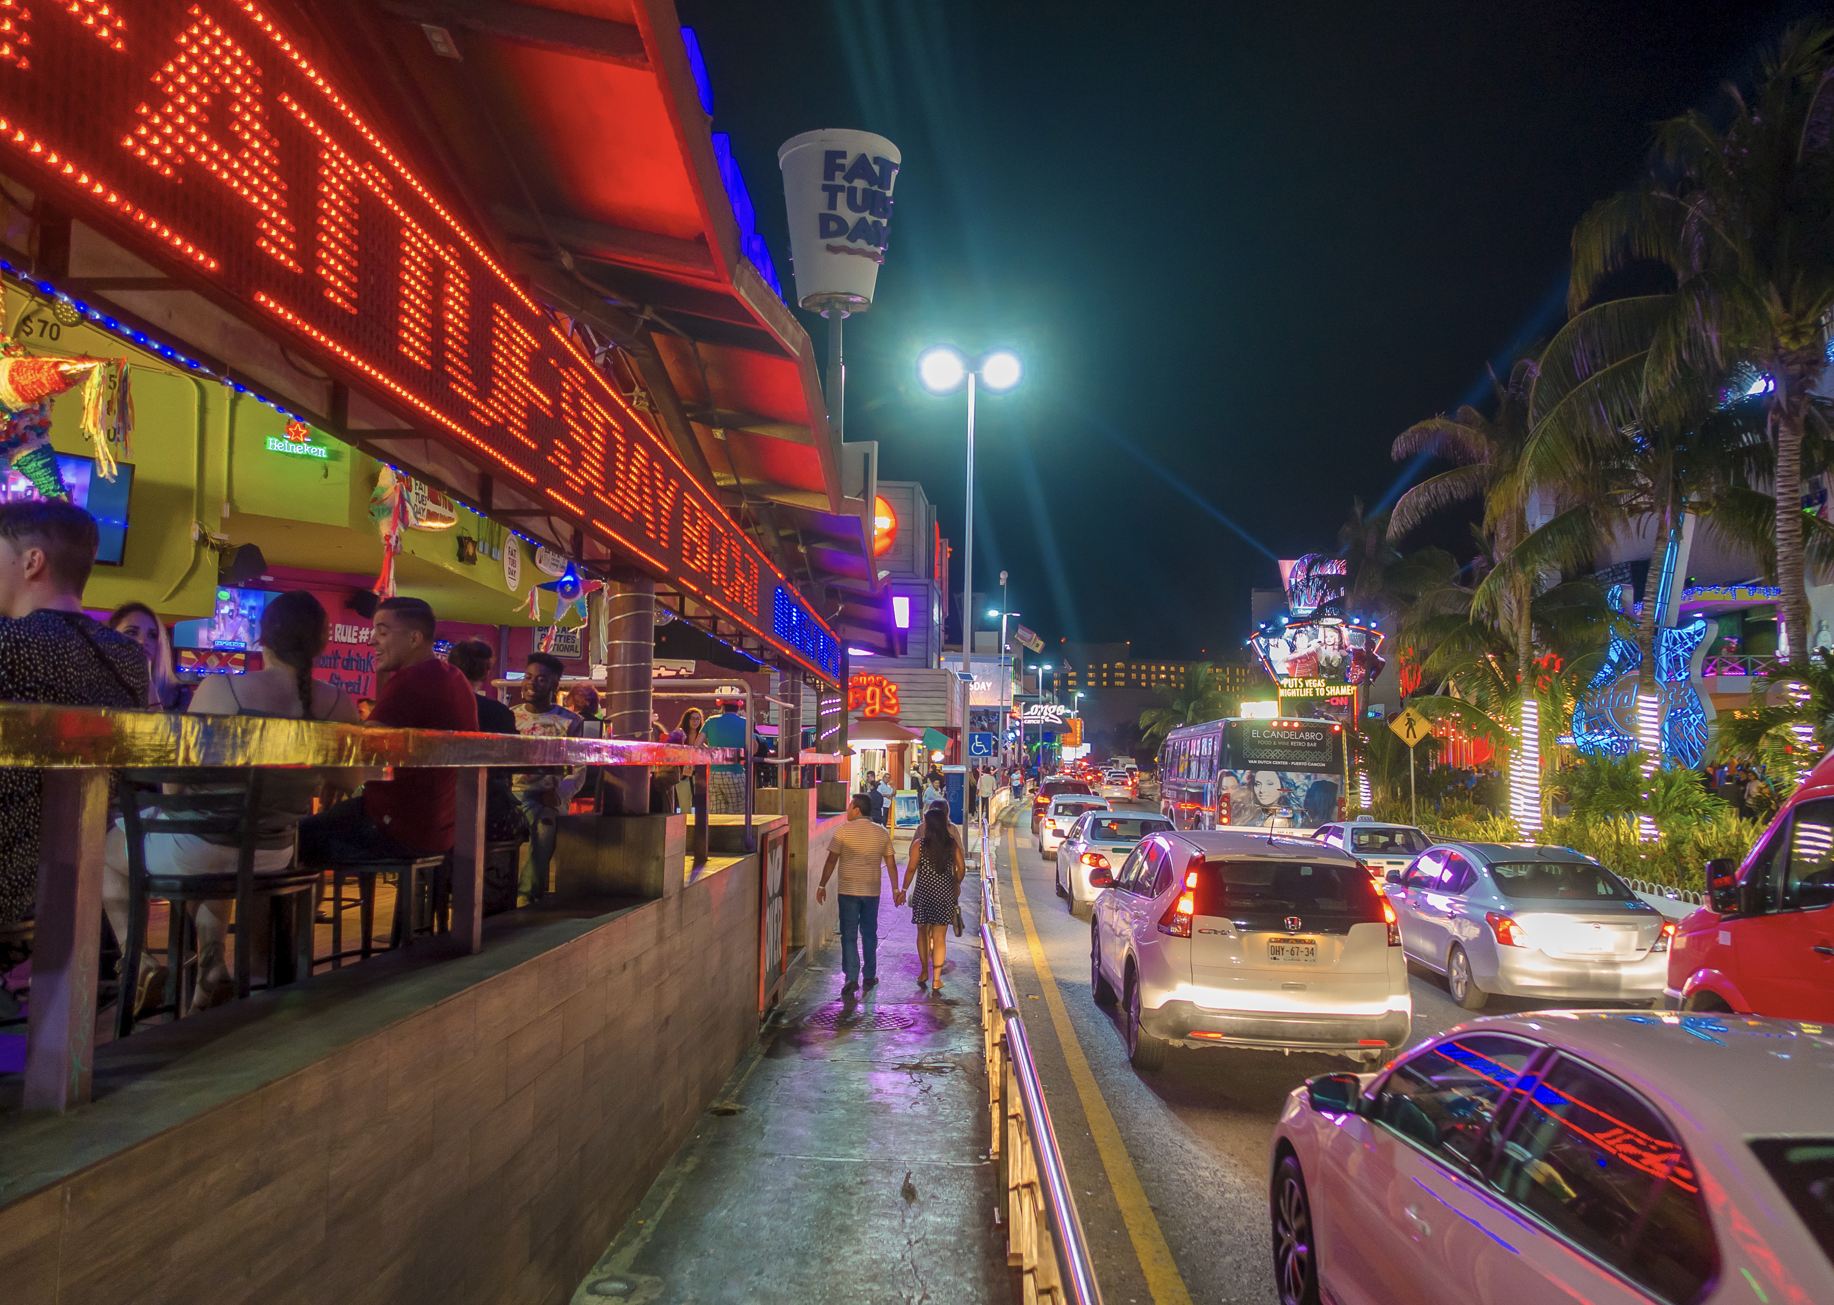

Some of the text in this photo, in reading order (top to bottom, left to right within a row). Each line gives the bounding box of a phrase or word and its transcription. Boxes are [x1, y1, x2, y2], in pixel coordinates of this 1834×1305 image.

[823, 150, 900, 190] FAT
[819, 212, 890, 249] DAY
[21, 316, 62, 341] $70
[267, 437, 328, 457] Heineken
[335, 623, 358, 644] RULE
[342, 650, 376, 673] drink
[1280, 688, 1314, 697] NIGHTLIFE
[1315, 687, 1325, 697] TO
[1283, 678, 1326, 688] PUTS VEGAS
[1251, 729, 1324, 741] EL CANDELABRO
